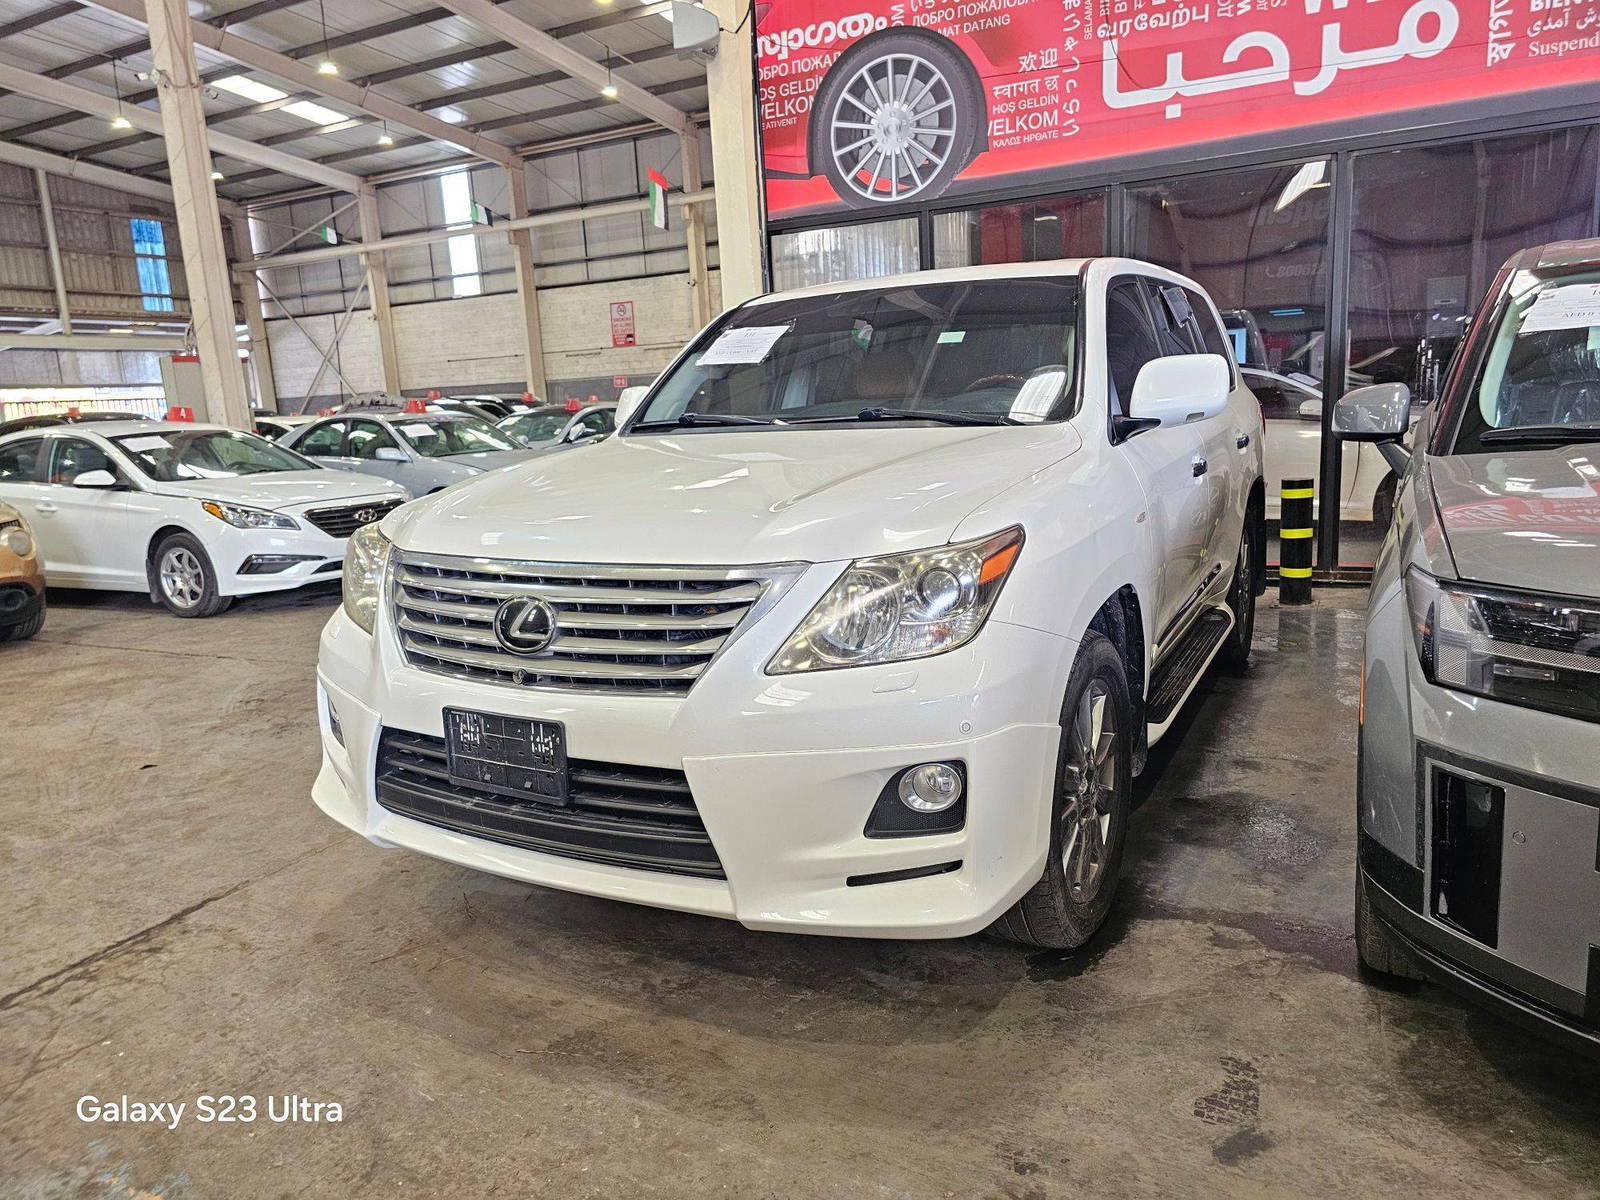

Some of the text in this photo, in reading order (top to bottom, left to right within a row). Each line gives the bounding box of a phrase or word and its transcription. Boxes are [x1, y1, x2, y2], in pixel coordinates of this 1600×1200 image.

[963, 14, 1011, 34] DATANG
[1017, 47, 1059, 73] 欢迎
[1102, 0, 1460, 119] مرحبا
[992, 78, 1041, 100] स्वागत
[992, 93, 1059, 115] HOŞ GELDİN
[987, 109, 1059, 137] ELKOM
